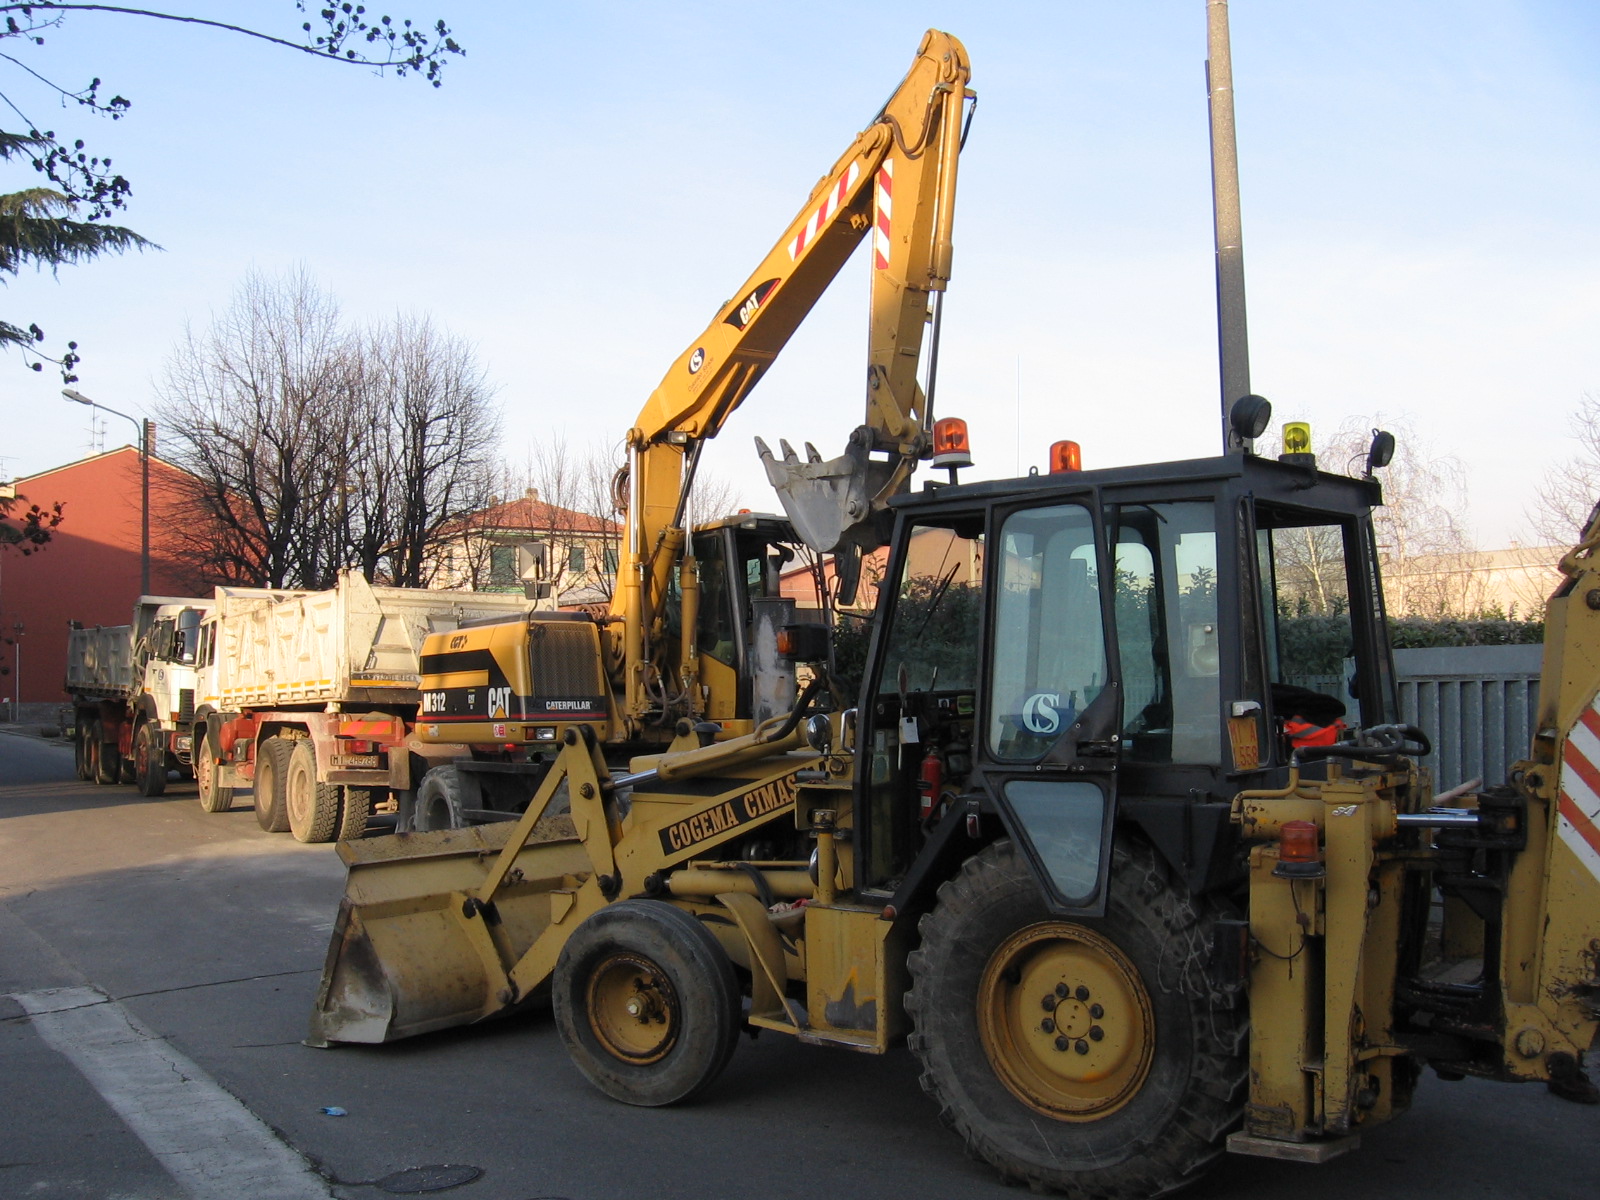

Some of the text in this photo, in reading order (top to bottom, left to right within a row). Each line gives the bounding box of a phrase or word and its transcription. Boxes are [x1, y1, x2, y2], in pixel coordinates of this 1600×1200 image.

[739, 292, 760, 325] CAT
[488, 687, 511, 719] CAT
[545, 701, 592, 710] CATERPILLAR
[668, 801, 739, 850] COGEMA
